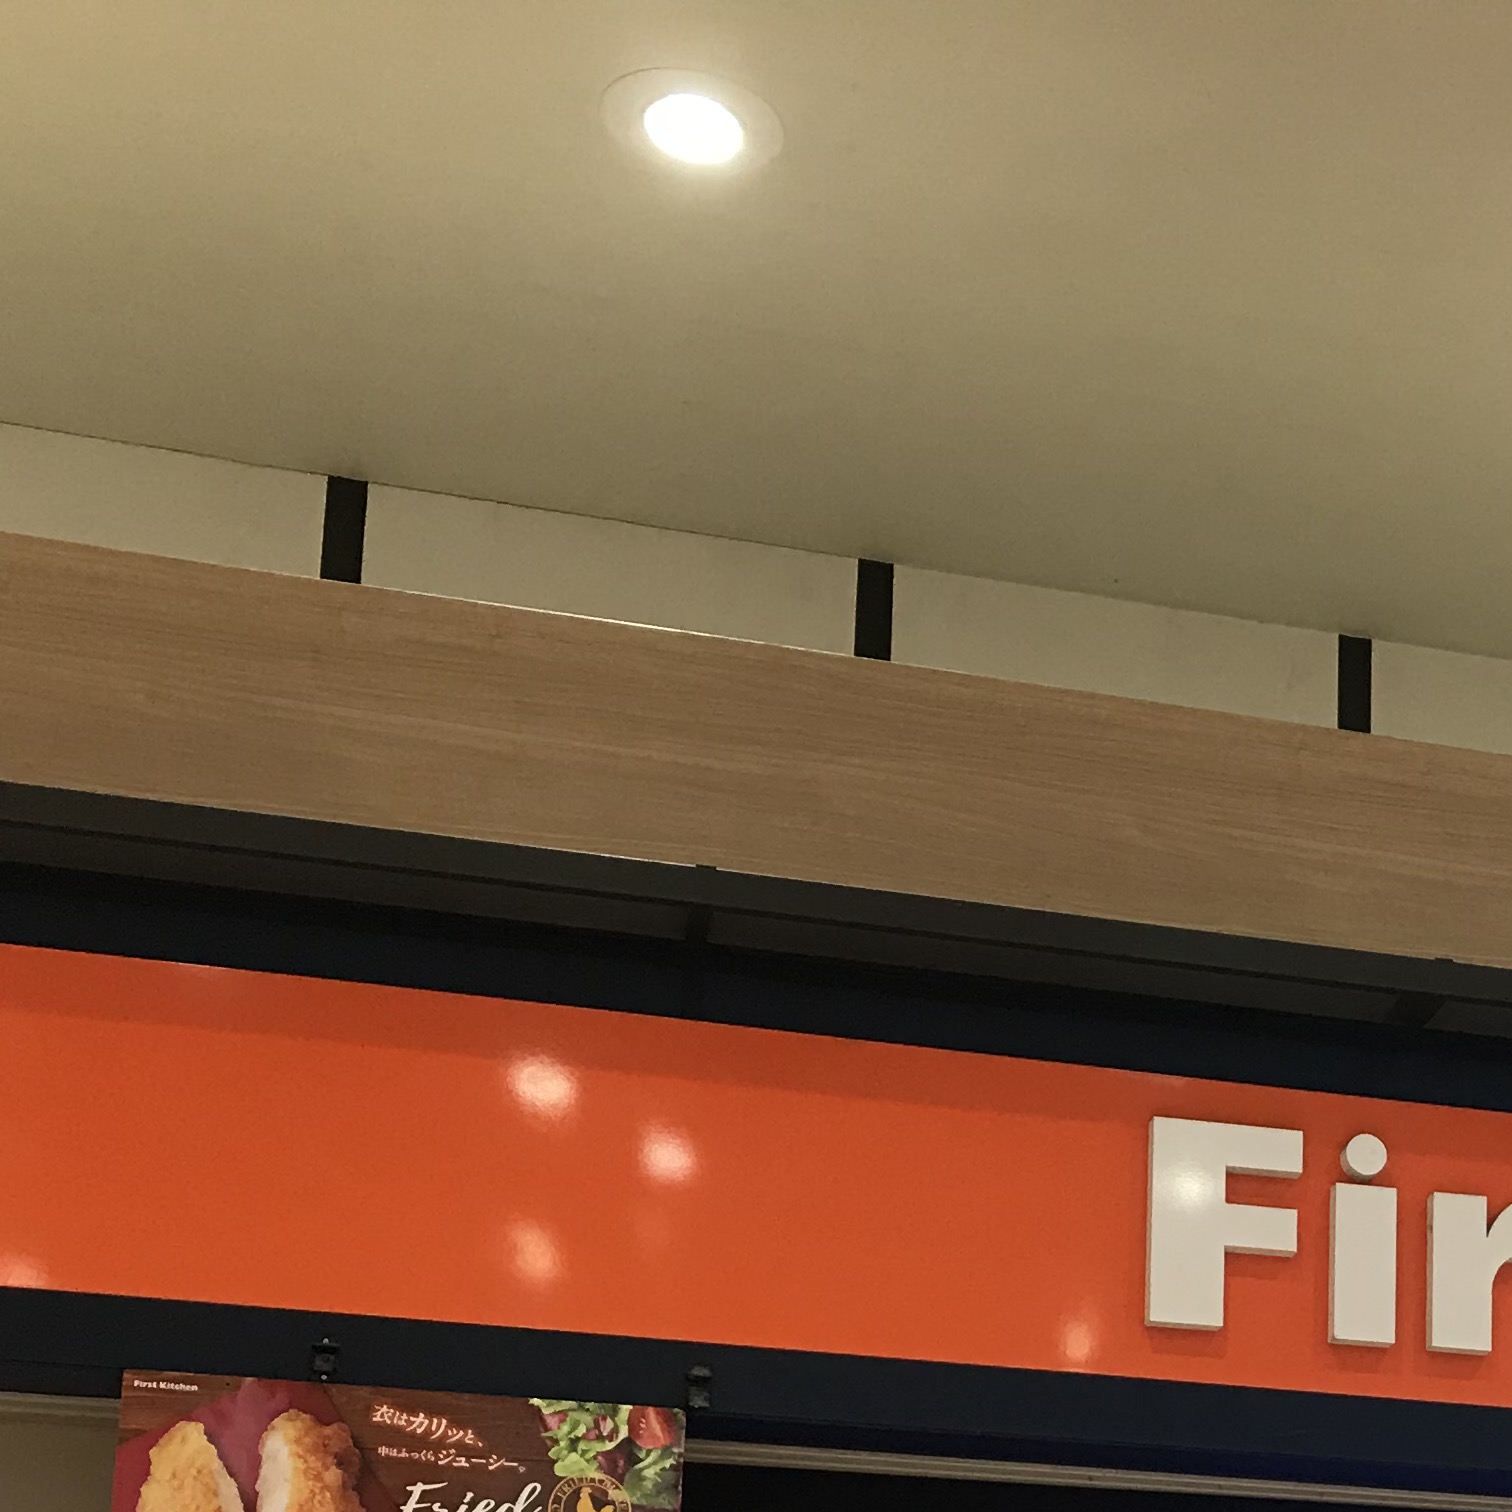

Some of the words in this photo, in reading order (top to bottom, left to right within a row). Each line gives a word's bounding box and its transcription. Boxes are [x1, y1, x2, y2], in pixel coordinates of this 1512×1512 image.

[134, 1380, 157, 1388] First
[160, 1382, 198, 1391] Kitchen
[372, 1404, 485, 1448] 衣はカリッと、
